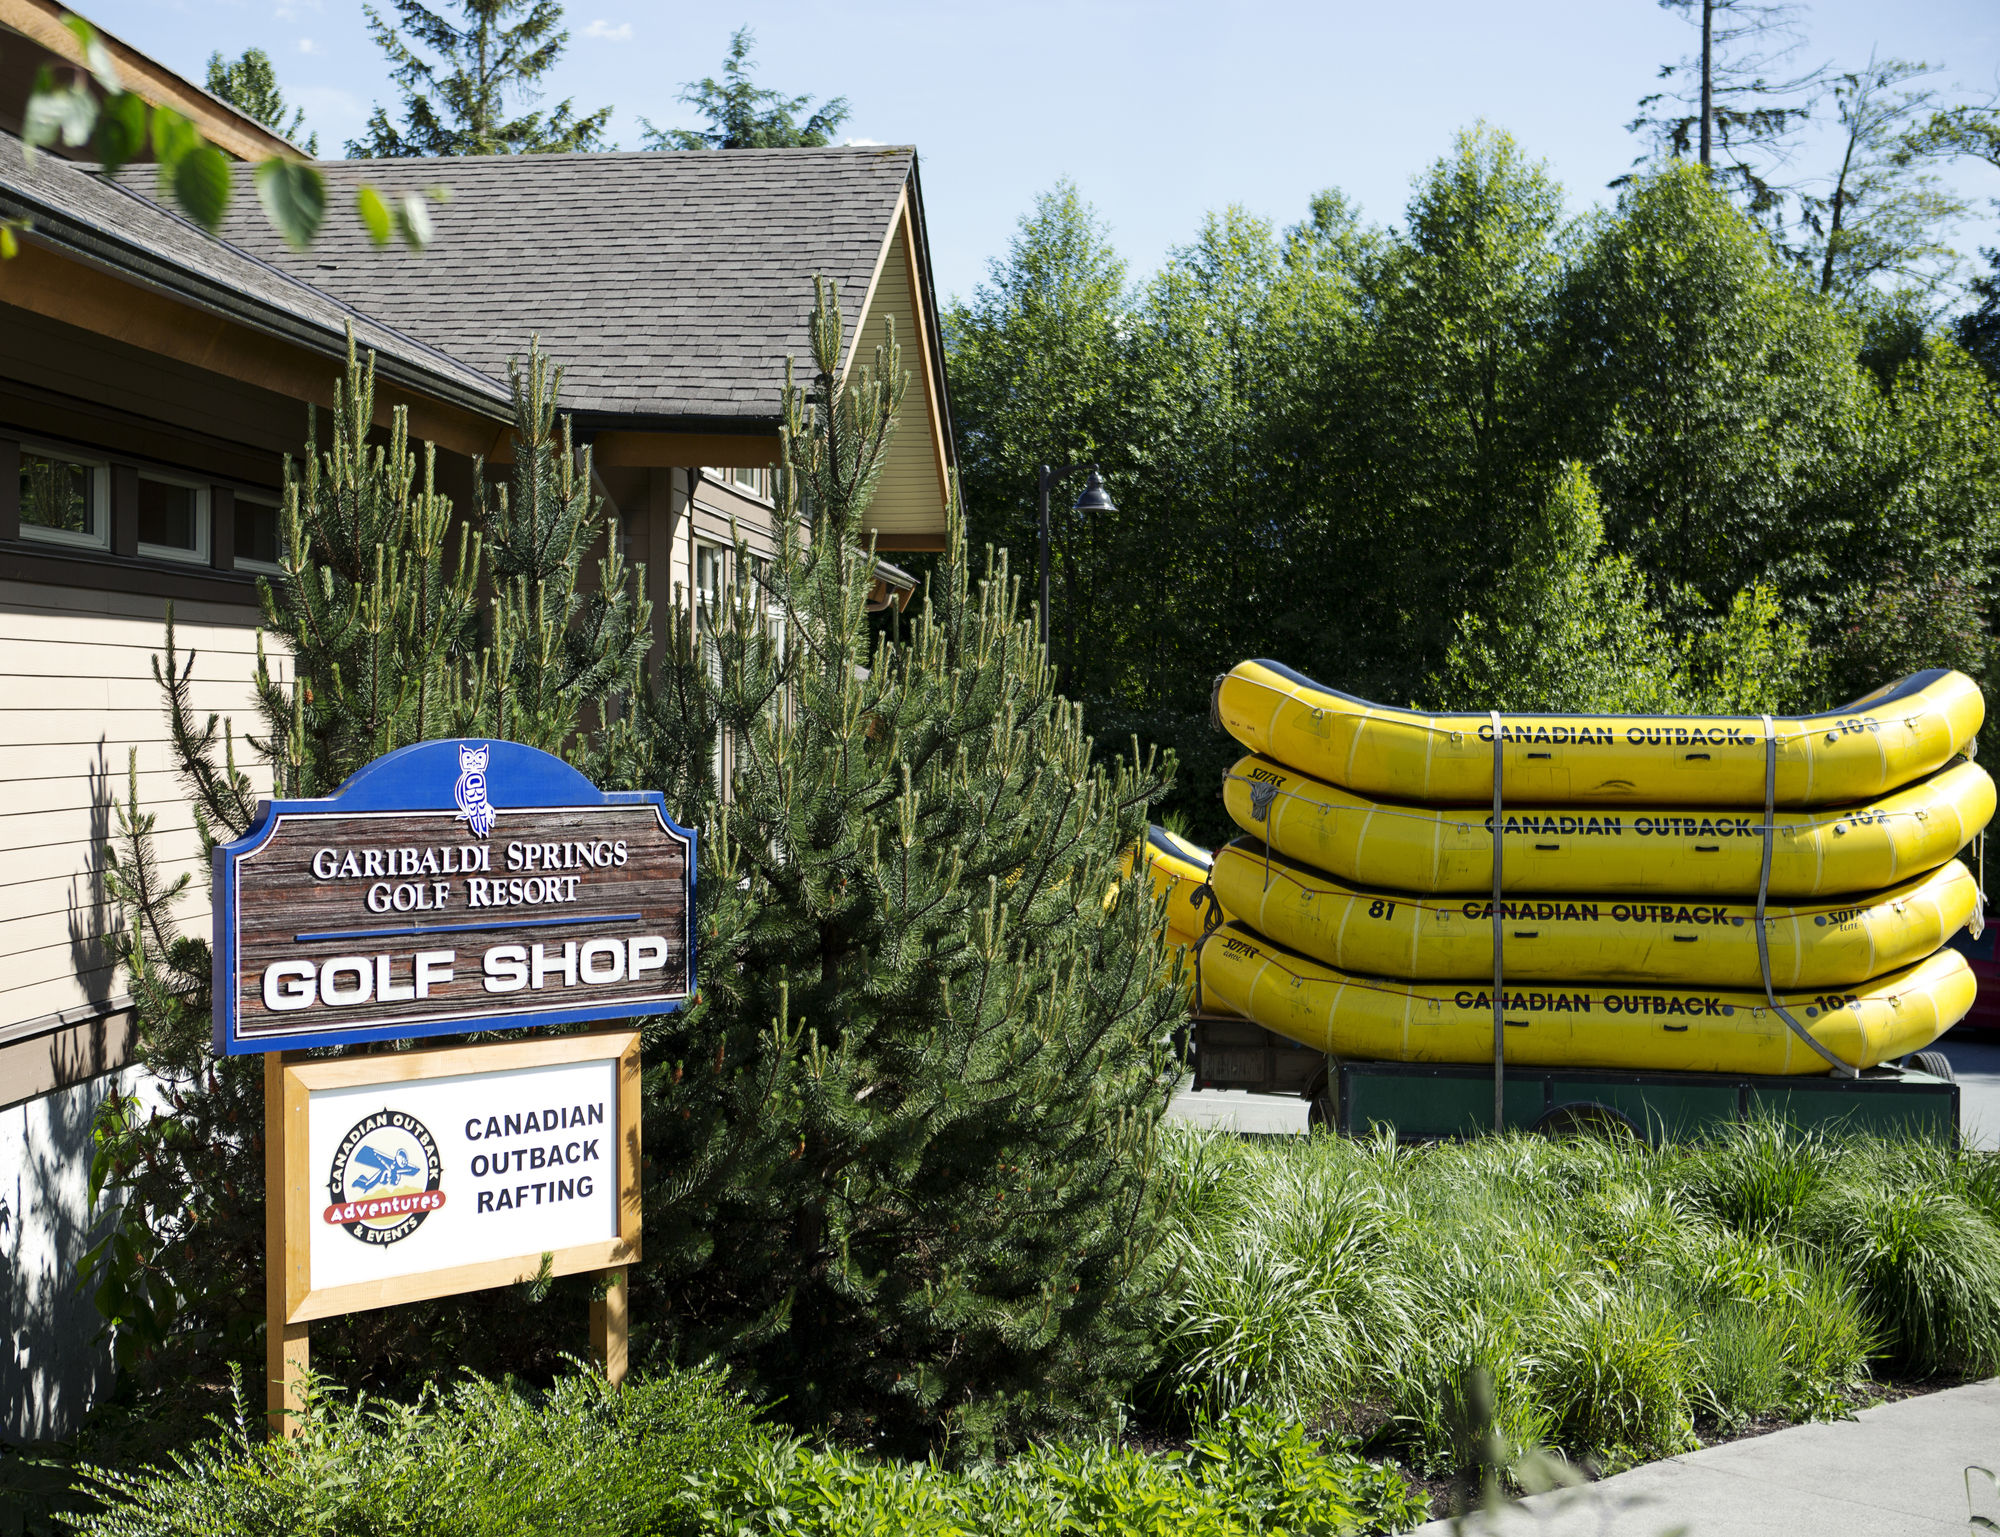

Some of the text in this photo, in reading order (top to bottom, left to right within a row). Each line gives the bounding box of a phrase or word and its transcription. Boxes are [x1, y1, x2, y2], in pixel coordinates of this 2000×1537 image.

[1478, 725, 1744, 746] CANADIAN OUTBACK
[1485, 816, 1752, 836] CANADIAN OUTBACK
[312, 840, 628, 880] GARIBALDI SPRINGS
[367, 876, 581, 913] GOLF RESORT
[1368, 900, 1396, 921] 81
[1462, 902, 1729, 925] CANADIAN OUTBACK
[263, 936, 668, 1011] GOLF SHOP
[1454, 991, 1721, 1016] CANADIAN OUTBACK
[465, 1103, 604, 1141] CANADIAN
[332, 1113, 439, 1194] CANADIAN OUTBACK
[471, 1139, 599, 1177] OUTBACK
[477, 1176, 594, 1214] RAFTING
[353, 1216, 418, 1243] & EVENTS
